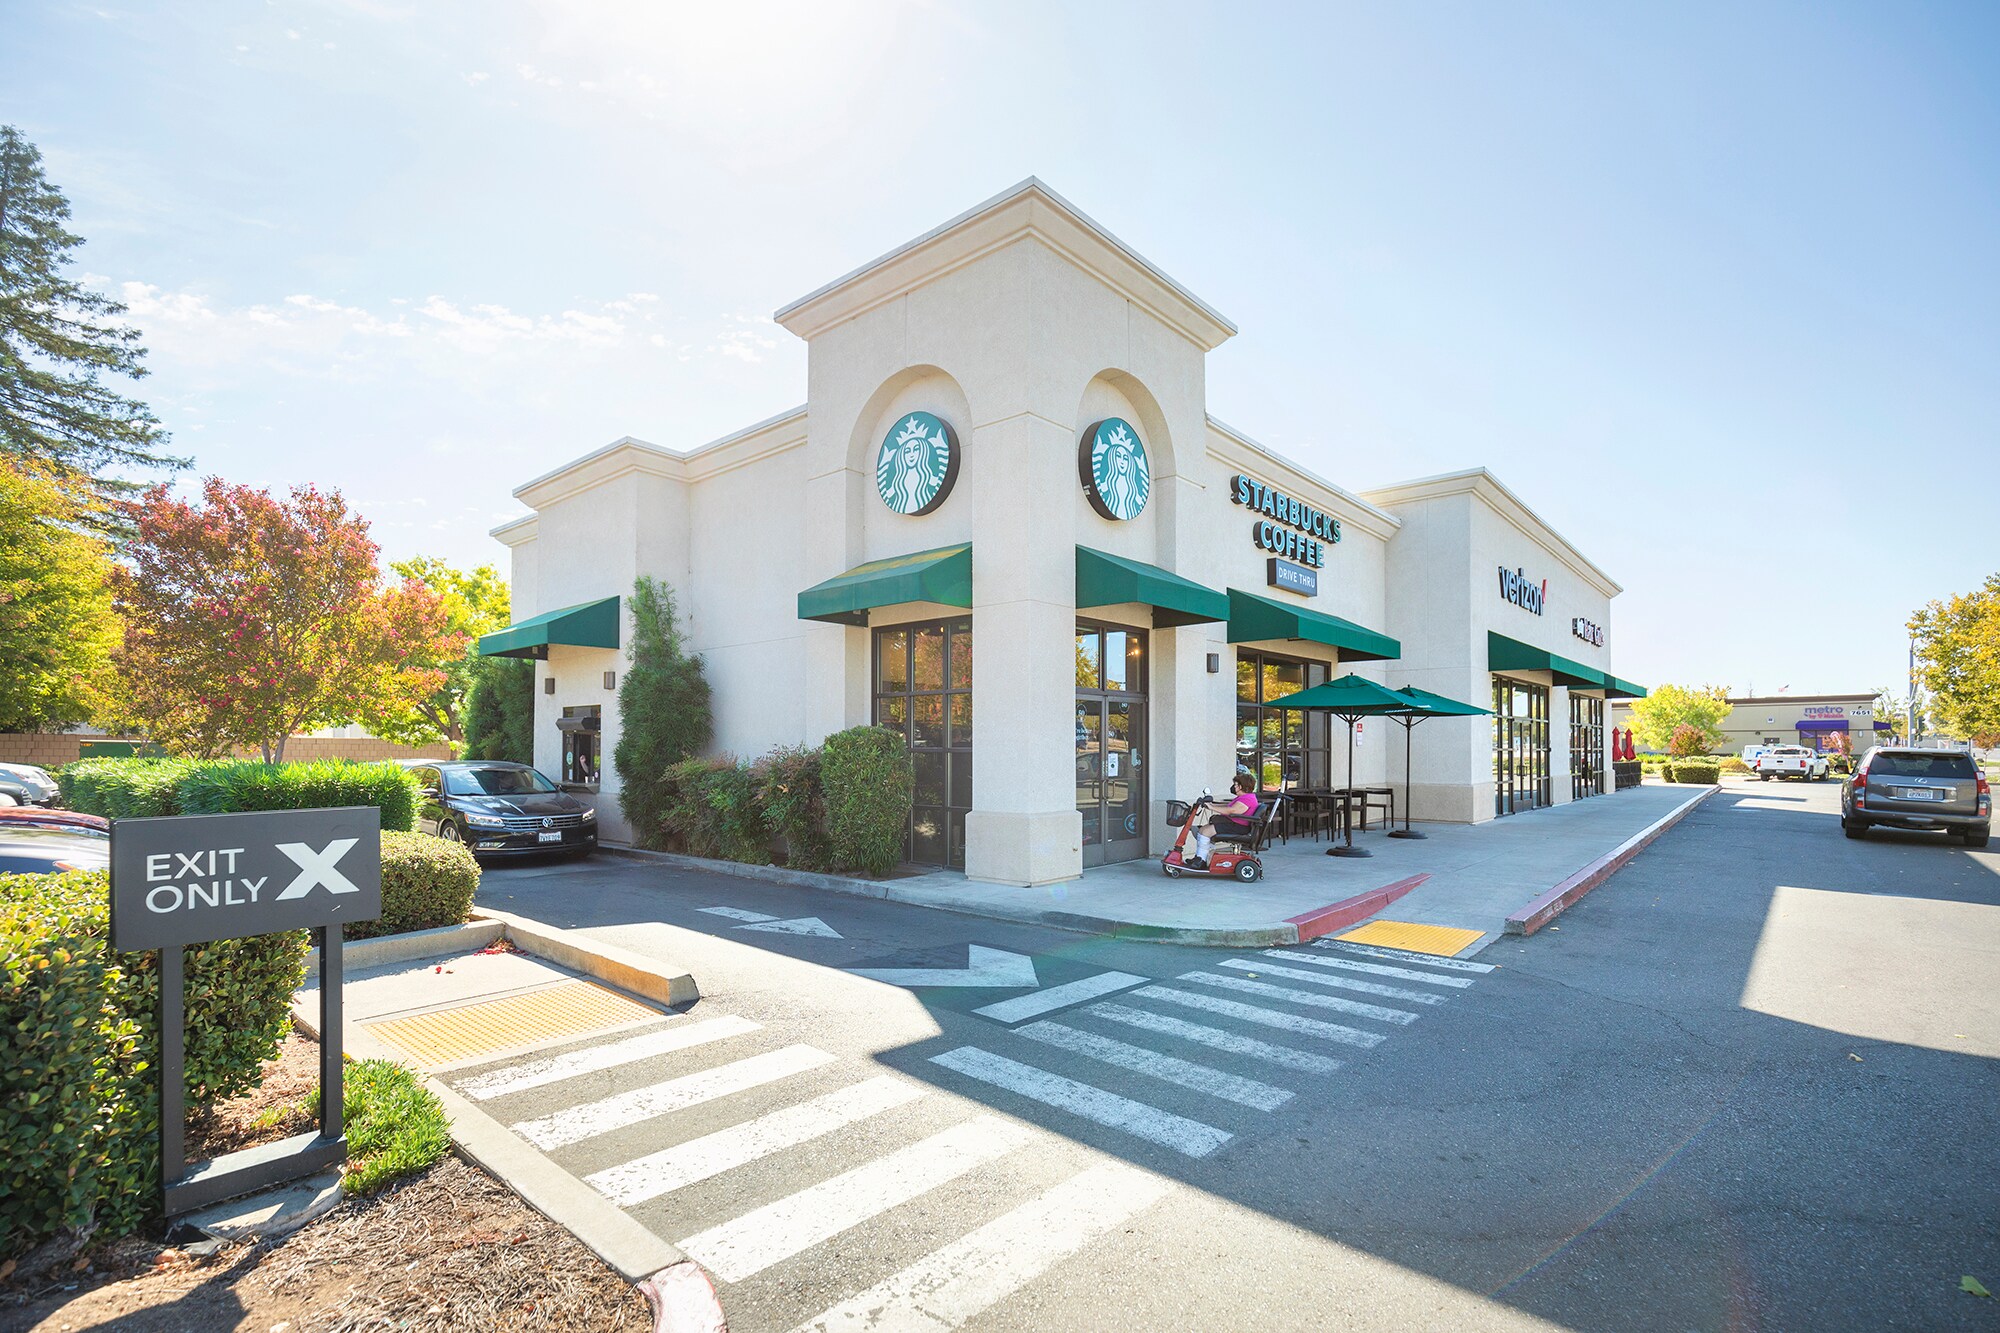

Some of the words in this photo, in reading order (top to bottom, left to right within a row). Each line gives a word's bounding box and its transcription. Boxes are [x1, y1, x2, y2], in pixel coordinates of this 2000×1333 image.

[1232, 474, 1341, 543] STARBUCKS
[1256, 520, 1325, 568] COFFEE
[1279, 567, 1298, 583] DRIVE
[1299, 573, 1316, 588] THRU
[1498, 566, 1544, 616] verizon
[146, 848, 245, 882] EXIT
[145, 876, 268, 914] ONLY
